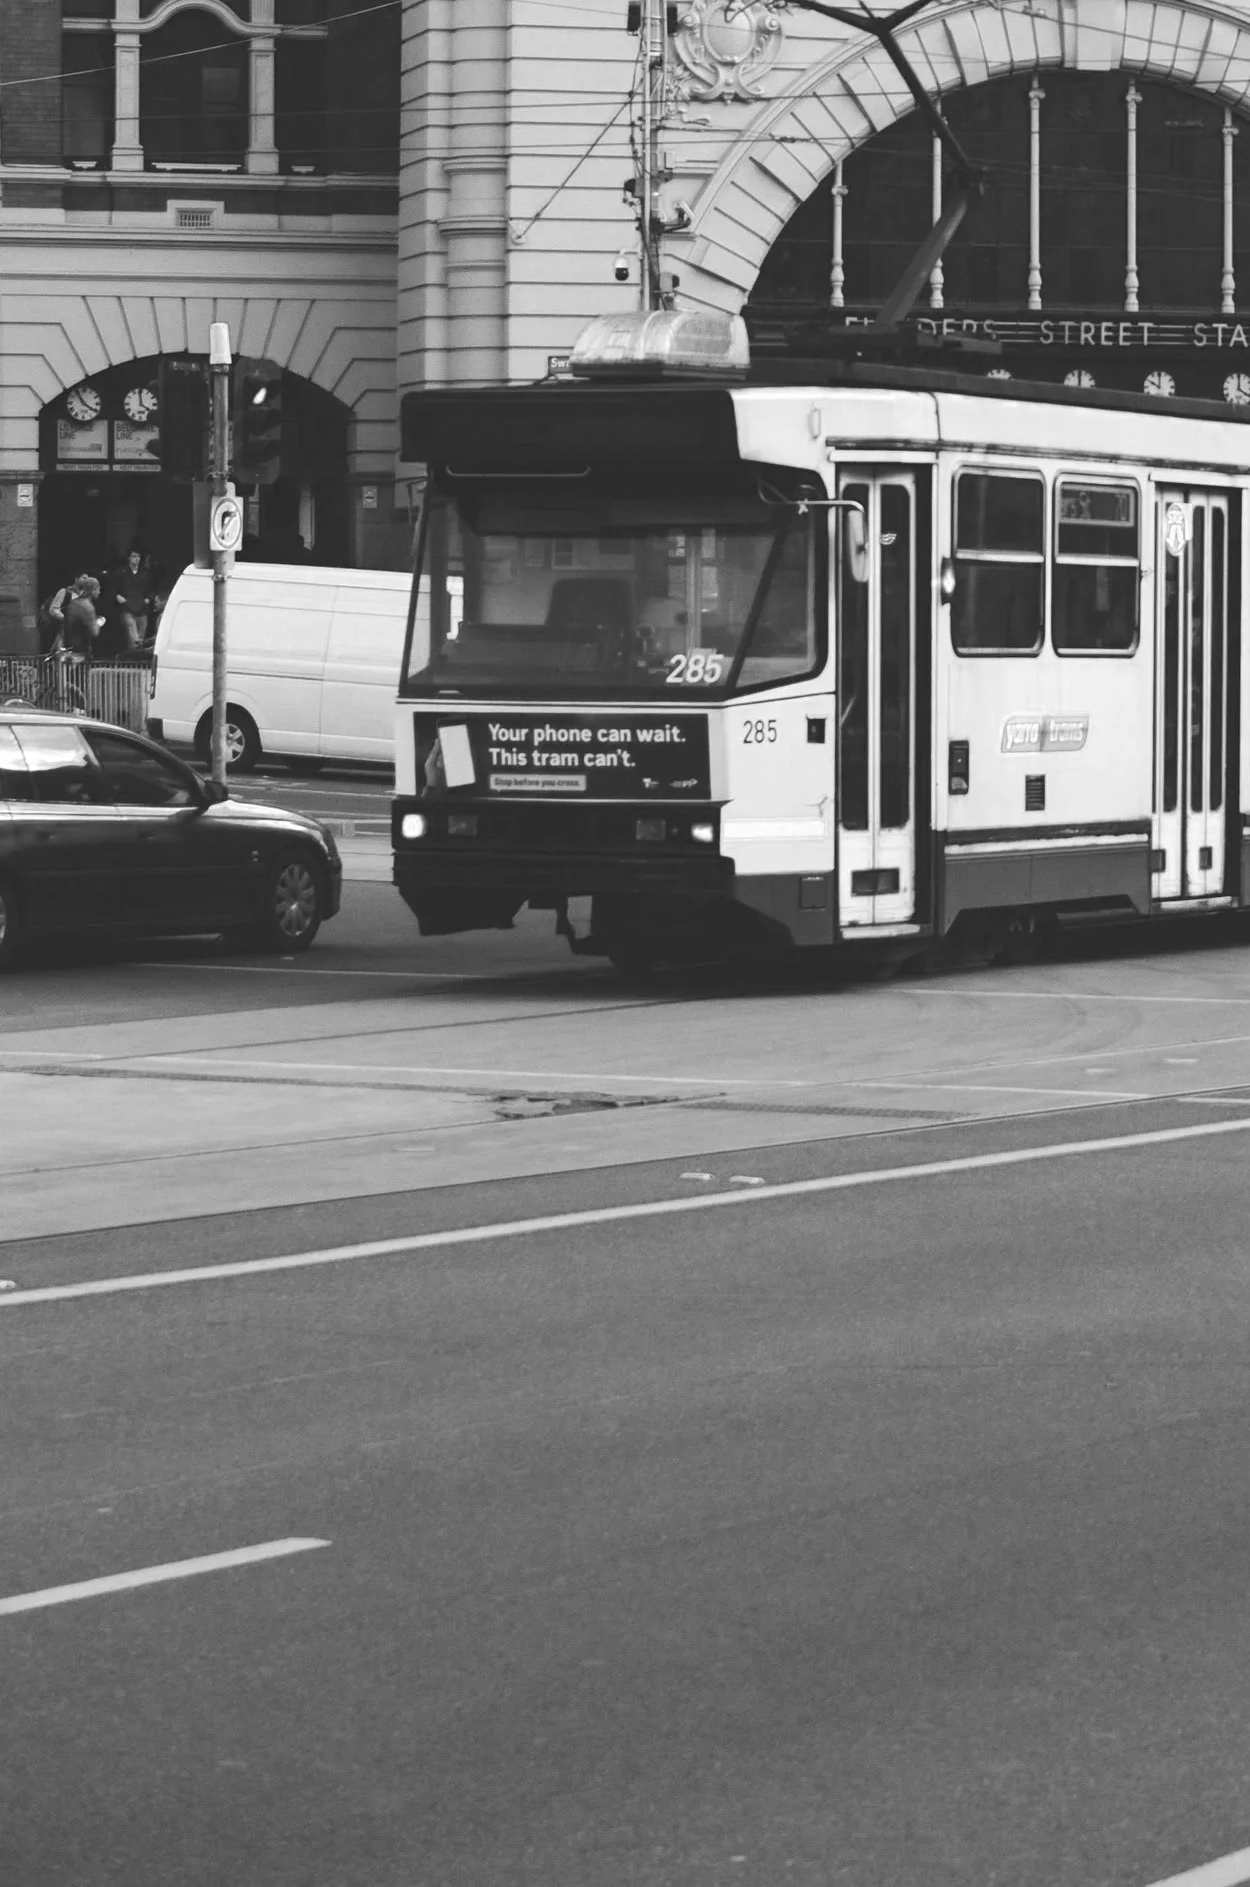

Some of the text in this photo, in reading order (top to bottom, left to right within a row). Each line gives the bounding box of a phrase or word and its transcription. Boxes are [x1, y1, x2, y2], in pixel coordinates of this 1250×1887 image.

[1040, 320, 1154, 346] STREET
[666, 653, 725, 684] 285
[488, 723, 686, 746] Your phone can wait.
[743, 719, 778, 744] 285
[488, 747, 528, 766] This
[532, 749, 579, 766] tram
